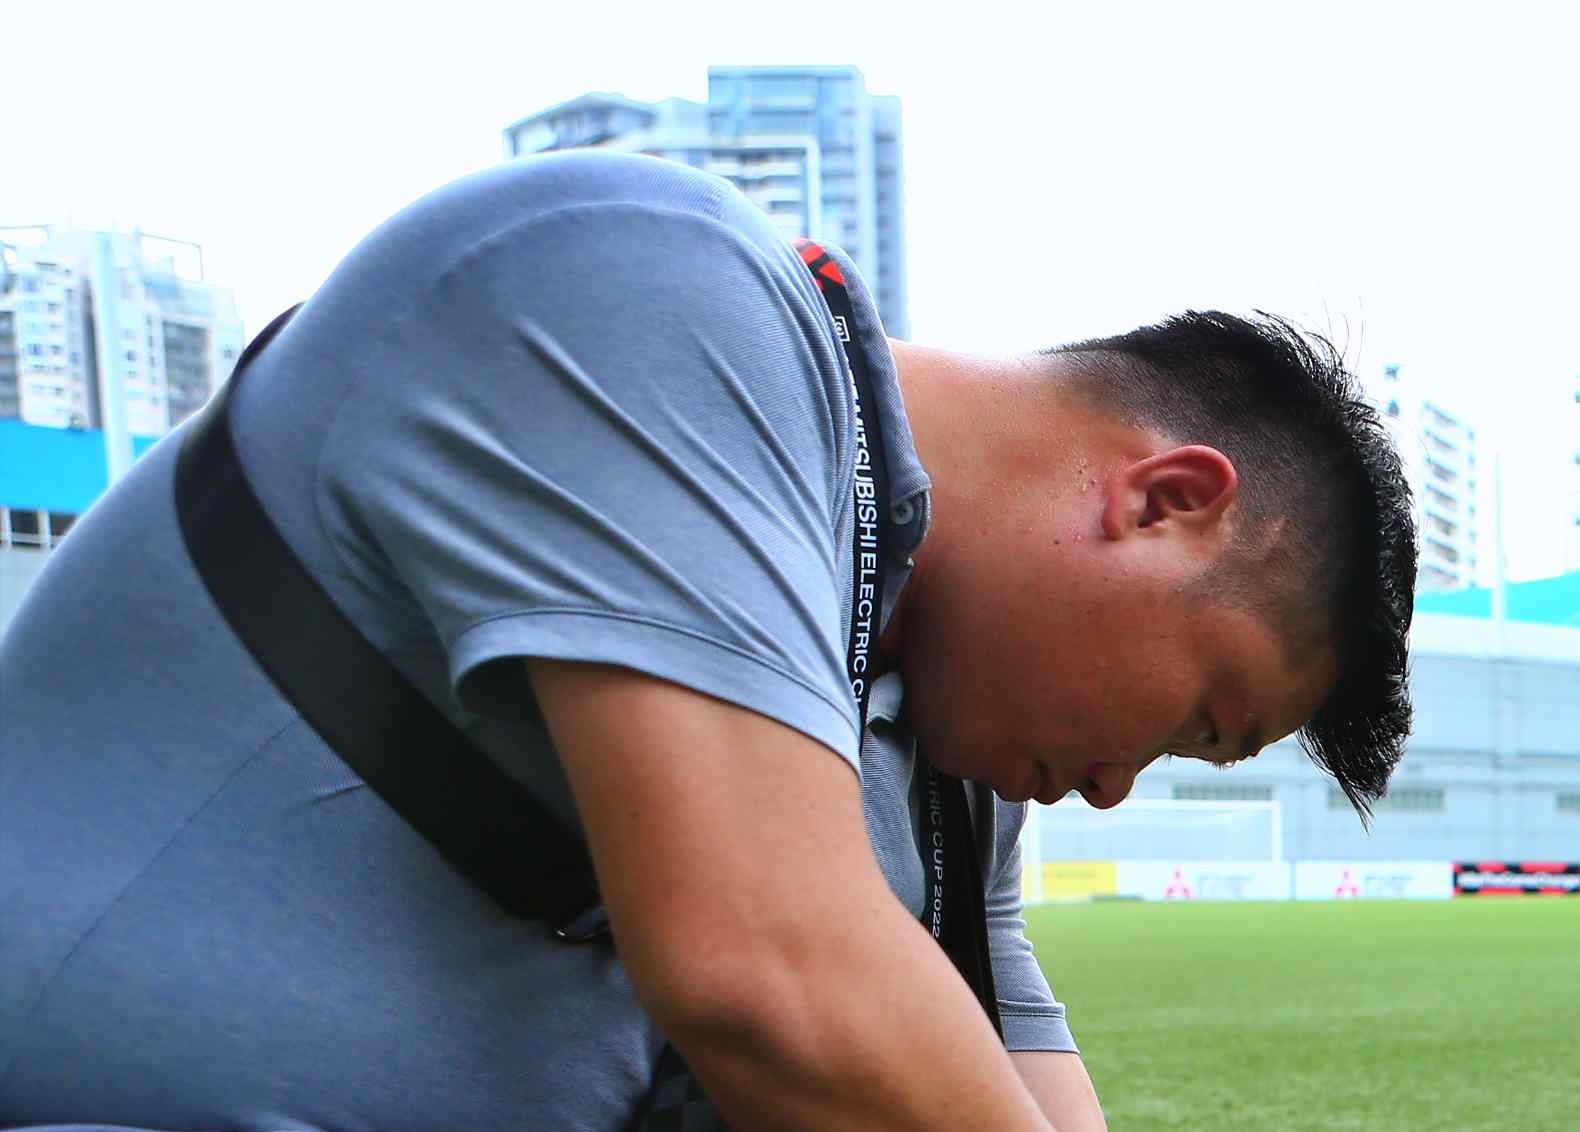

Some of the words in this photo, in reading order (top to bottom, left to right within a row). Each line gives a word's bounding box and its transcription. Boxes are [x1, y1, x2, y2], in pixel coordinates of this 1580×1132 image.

[854, 552, 877, 673] ELECTRIC
[932, 832, 944, 881] CUP
[932, 885, 943, 938] 2022
